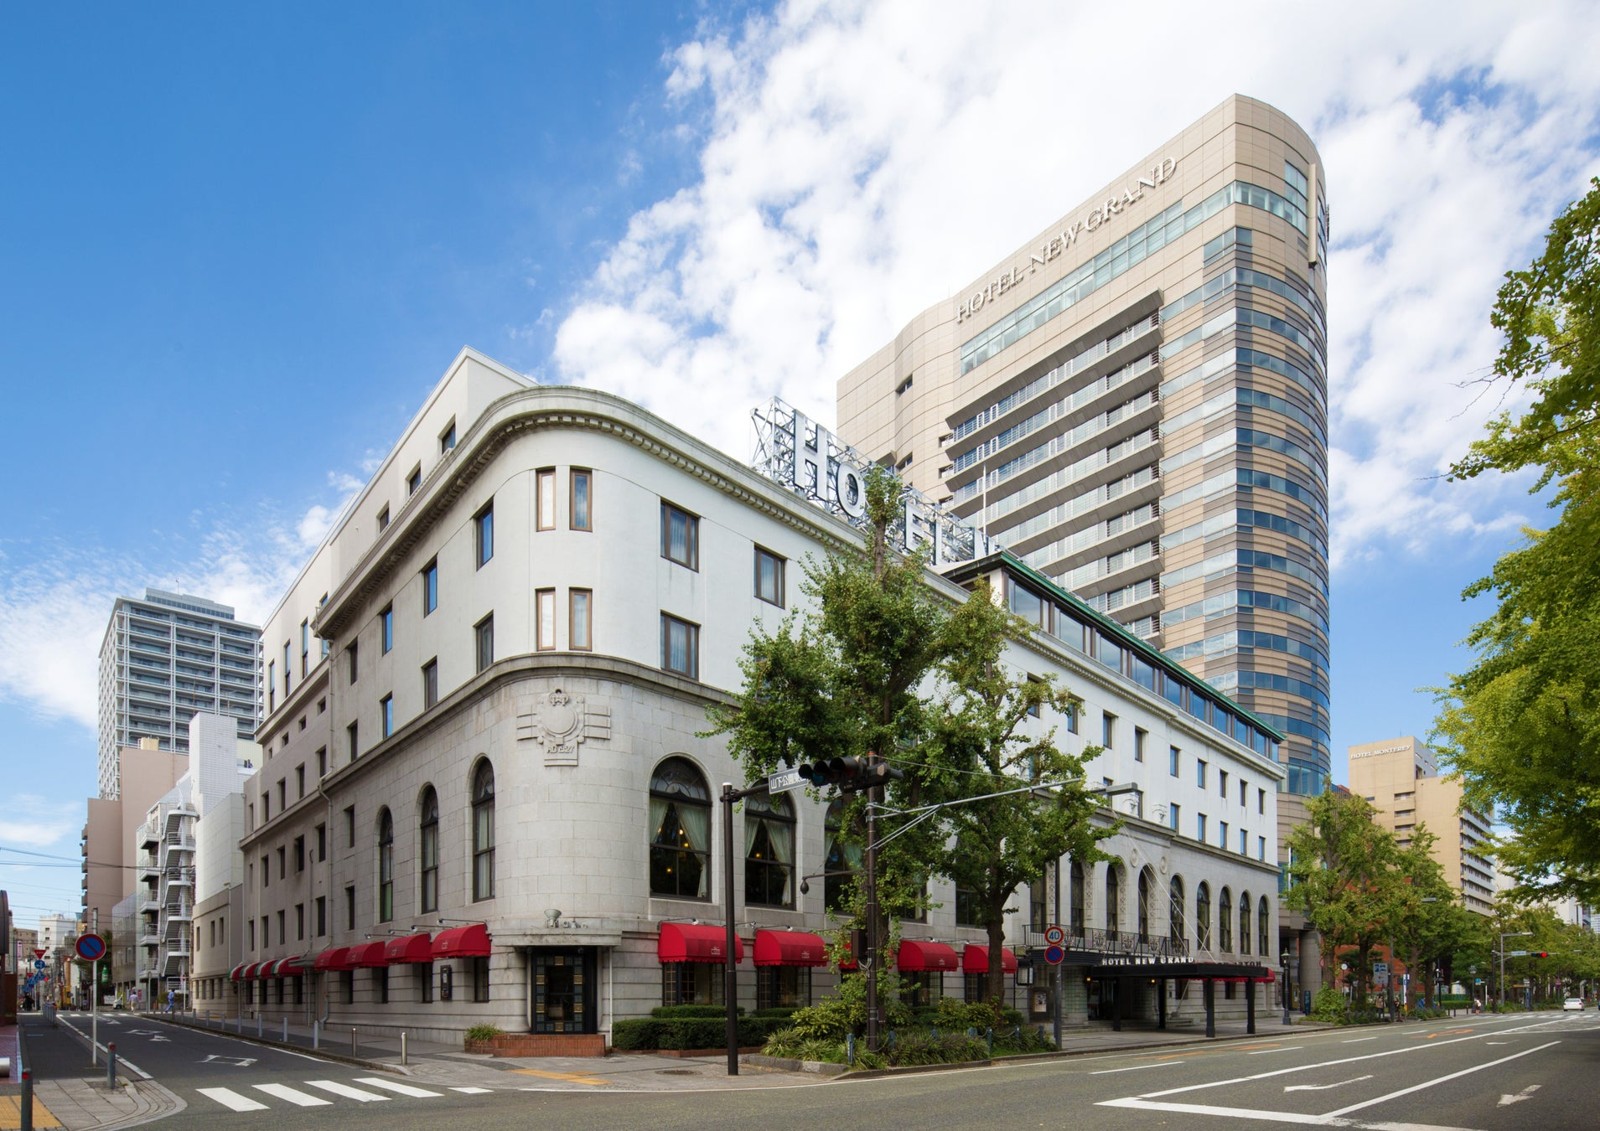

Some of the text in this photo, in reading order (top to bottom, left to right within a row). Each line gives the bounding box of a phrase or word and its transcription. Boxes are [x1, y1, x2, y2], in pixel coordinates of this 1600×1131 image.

[955, 156, 1177, 324] HOTEL NEW GRAND
[793, 408, 946, 566] HOEL
[1049, 931, 1060, 940] 40
[1102, 956, 1194, 966] HOTEL NEW GRAND
